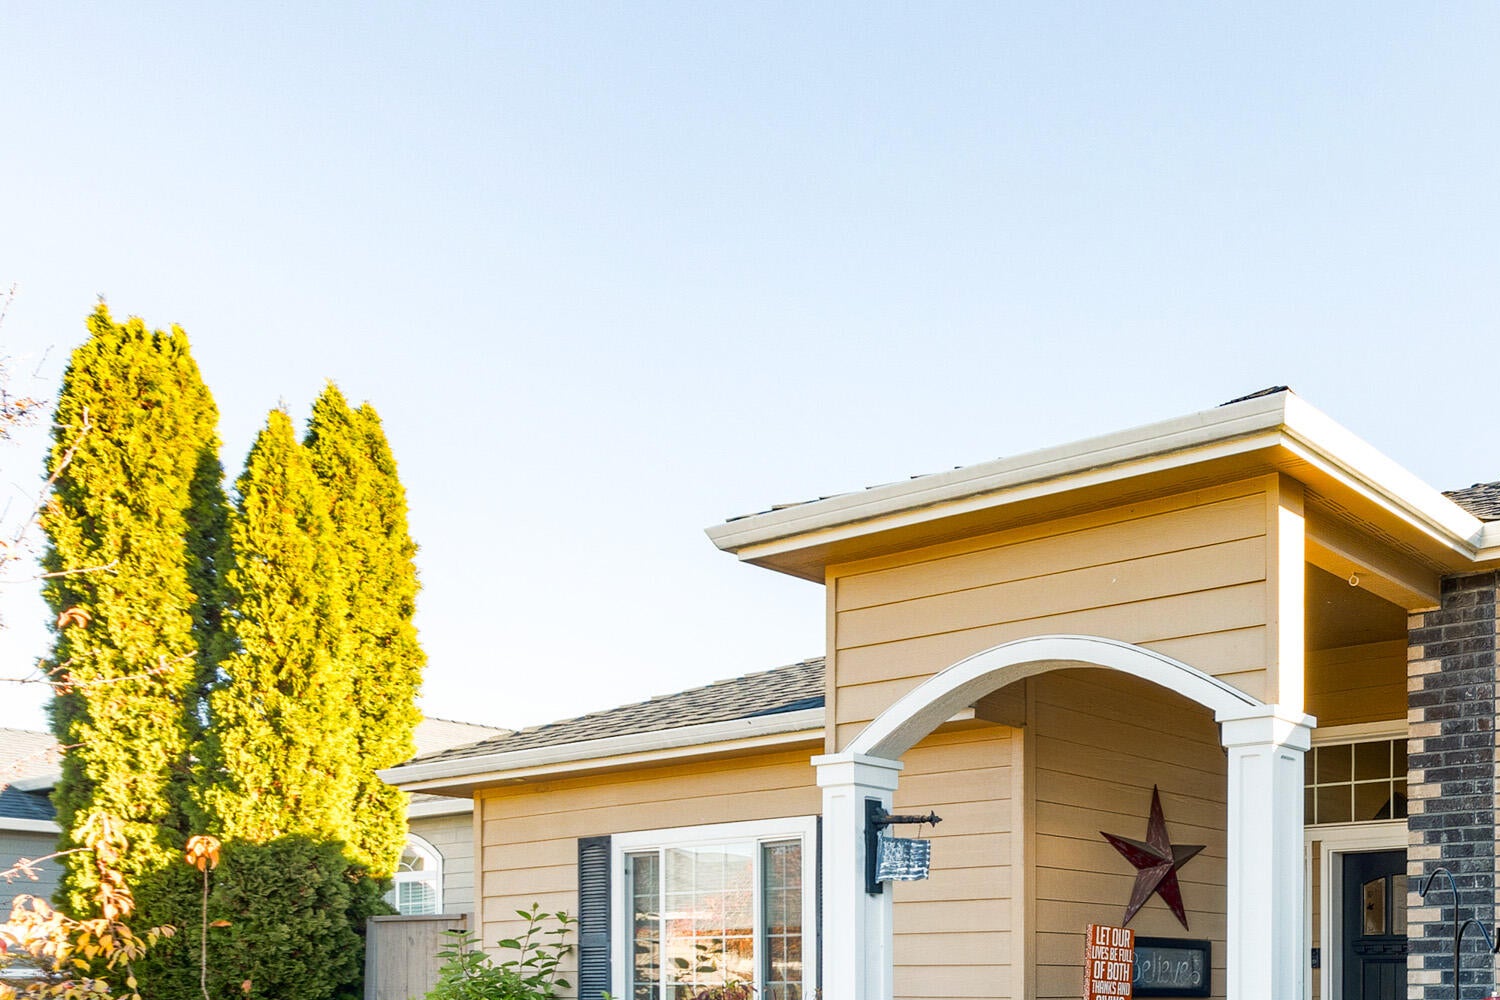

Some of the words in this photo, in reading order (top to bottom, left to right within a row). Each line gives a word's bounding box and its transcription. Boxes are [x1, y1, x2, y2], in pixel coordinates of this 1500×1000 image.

[1096, 926, 1111, 946] LET
[1112, 928, 1131, 948] OUR
[1092, 945, 1109, 960] LIVES
[1110, 948, 1119, 961] BE
[1118, 949, 1133, 963] FULL
[1093, 961, 1106, 979] OF
[1107, 962, 1130, 981] BOTH
[1092, 980, 1116, 995] THANKS
[1117, 982, 1131, 996] AND
